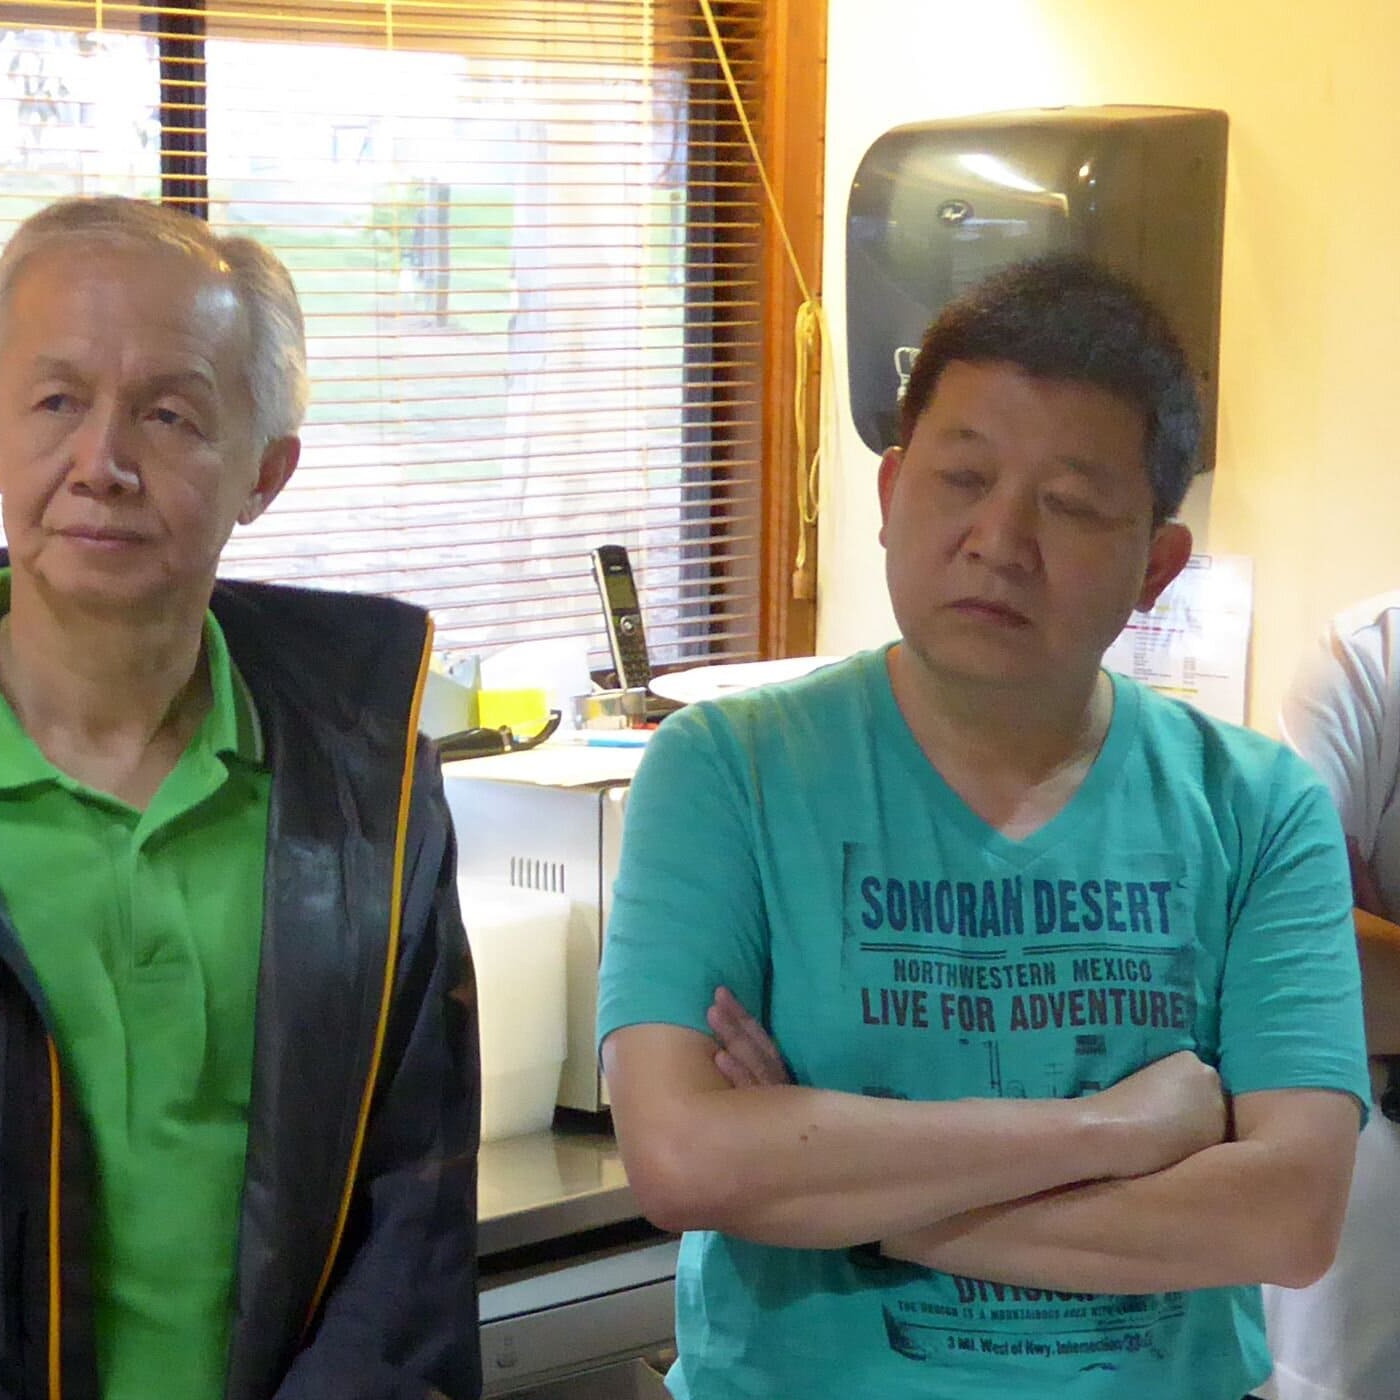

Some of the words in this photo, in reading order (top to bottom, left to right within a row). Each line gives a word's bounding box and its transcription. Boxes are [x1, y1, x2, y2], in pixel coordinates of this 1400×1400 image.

[860, 874, 1024, 938] SONORAN
[1033, 878, 1172, 935] DESERT
[893, 957, 1057, 990] NORTHWESTERN
[1072, 956, 1153, 983] MEXICO
[860, 987, 929, 1028] LIVE
[941, 992, 997, 1033] FOR
[1009, 988, 1187, 1032] ADVENTURE
